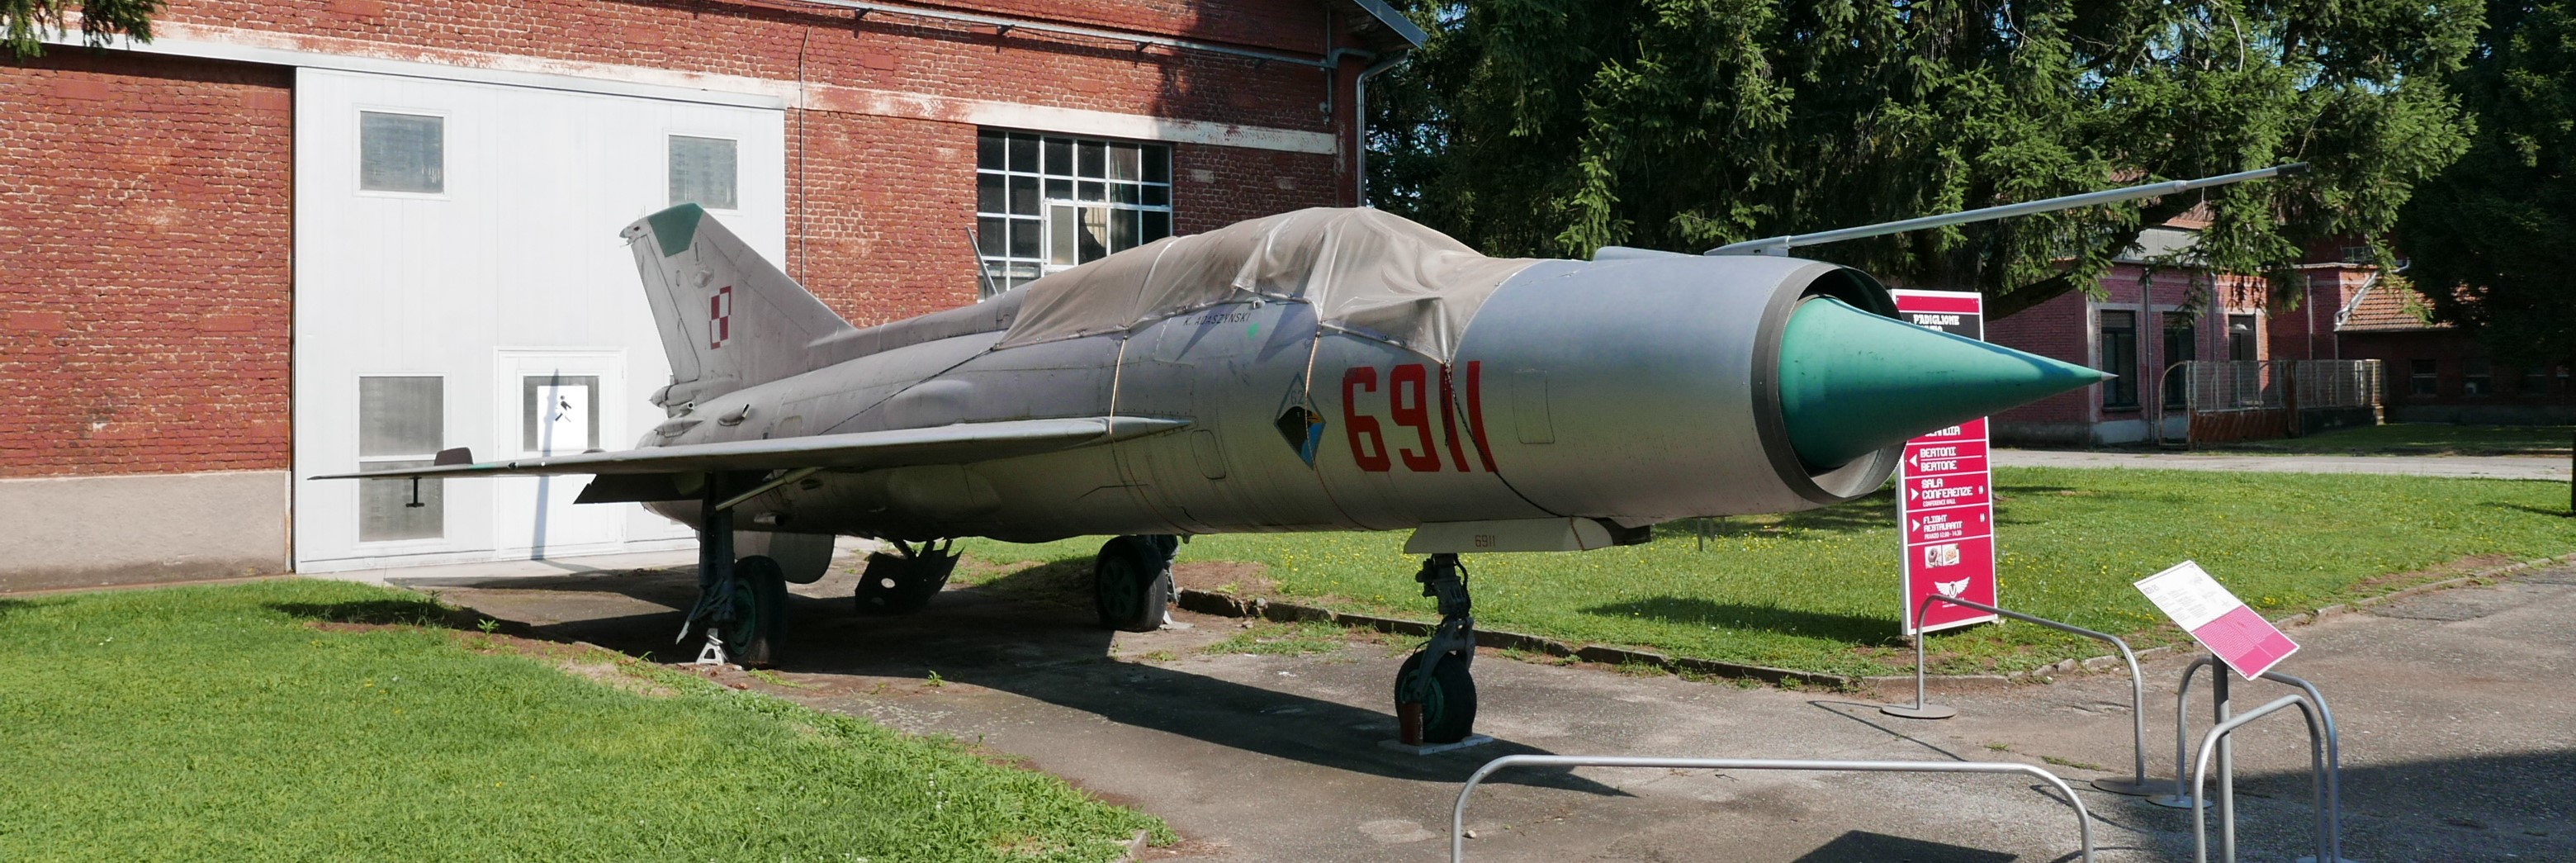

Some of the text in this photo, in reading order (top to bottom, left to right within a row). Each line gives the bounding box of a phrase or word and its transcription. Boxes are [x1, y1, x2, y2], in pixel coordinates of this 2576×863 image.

[1913, 314, 1959, 325] PADIGLIONE
[1290, 390, 1305, 405] 62
[1342, 361, 1499, 472] 6911
[1920, 447, 1956, 458] BERTONI
[1921, 460, 1957, 472] BERTONE
[1921, 478, 1943, 489] SALA
[1922, 486, 1972, 499] CONFERENZE
[1923, 514, 1947, 524] FLIGHT
[1924, 521, 1962, 533] RESTAURANT
[1475, 534, 1496, 548] 6911
